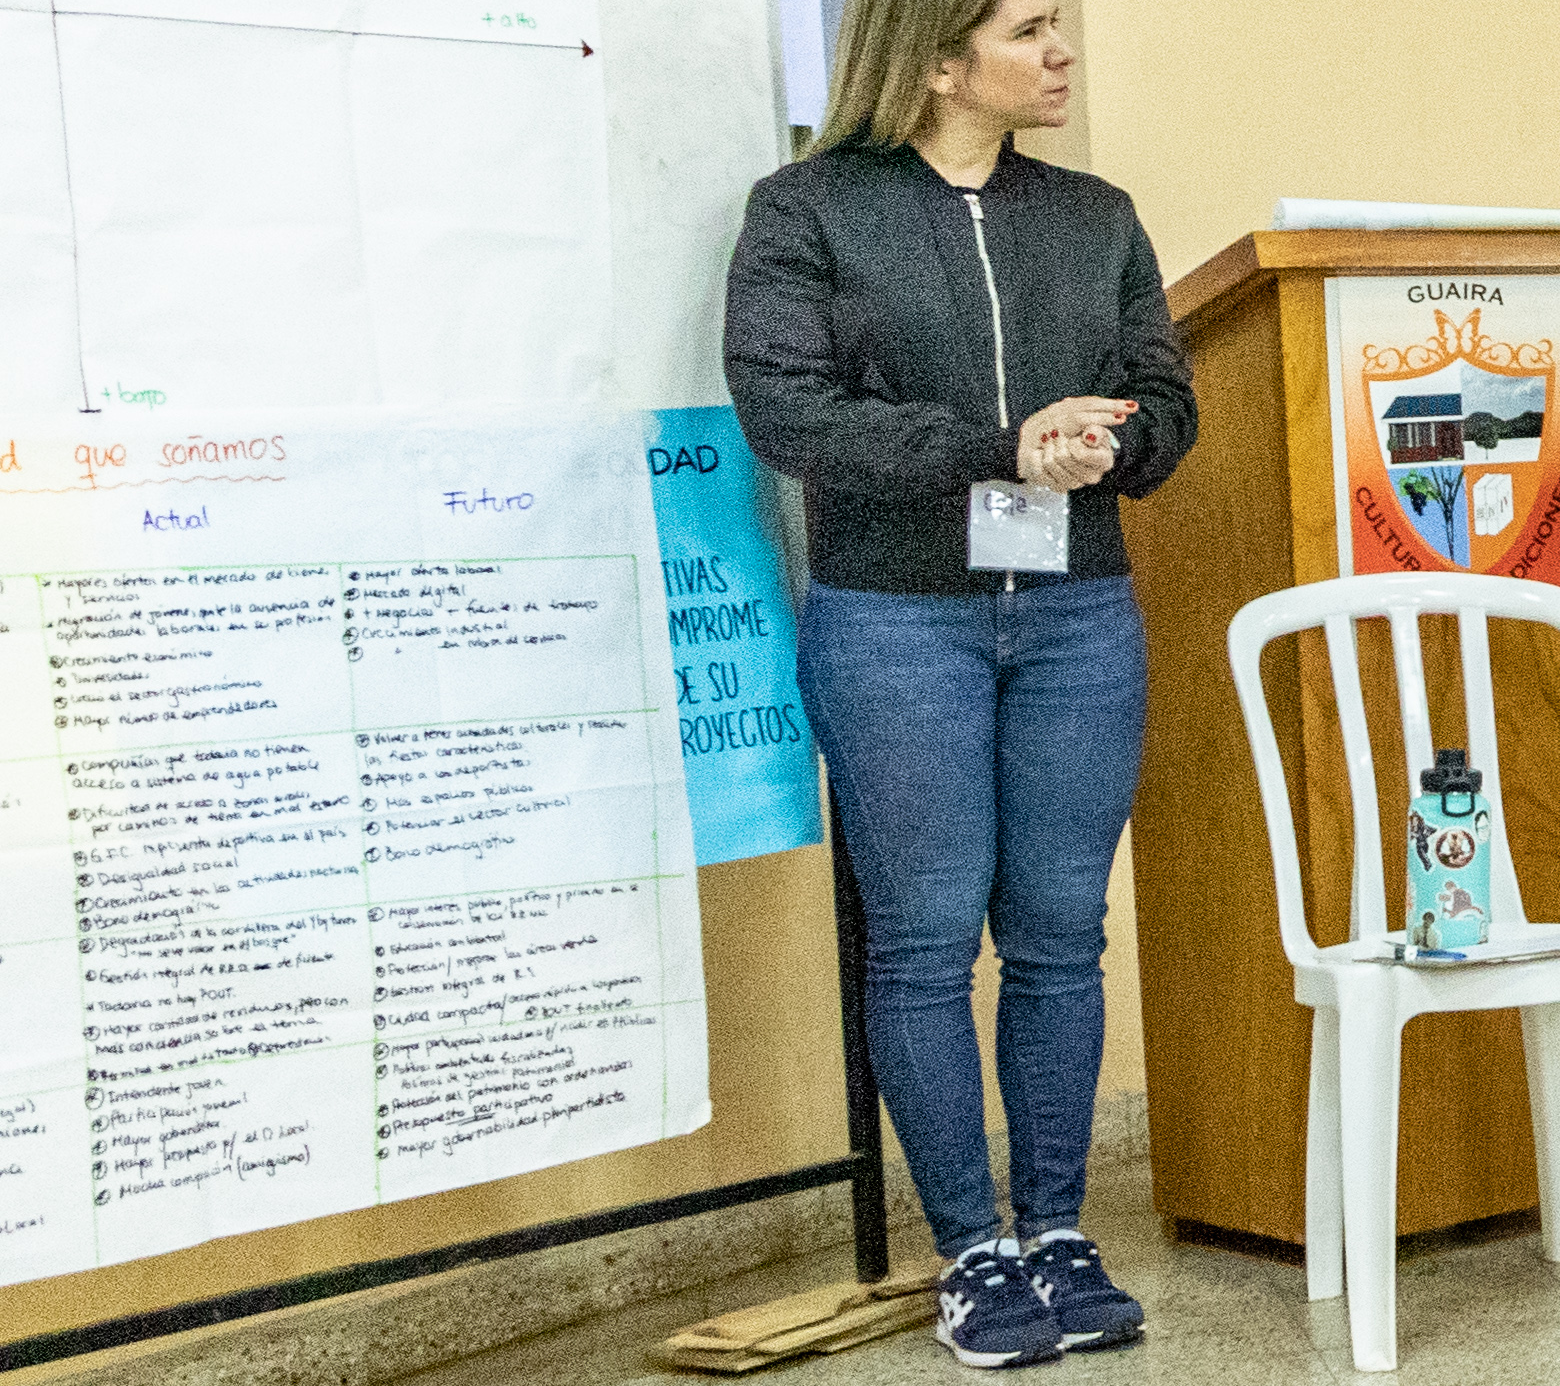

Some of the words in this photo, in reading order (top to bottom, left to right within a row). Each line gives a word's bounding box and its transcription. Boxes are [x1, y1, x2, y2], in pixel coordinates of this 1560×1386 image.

[501, 12, 537, 29] alto
[1407, 282, 1505, 305] GUAIRA
[75, 443, 126, 489] que
[160, 435, 286, 467] soñamos
[649, 445, 719, 476] DAD
[443, 487, 534, 515] Futuro
[143, 504, 210, 531] Actual
[661, 555, 728, 596] TIVAS
[708, 662, 739, 703] SU
[680, 704, 800, 756] ROYECTOS
